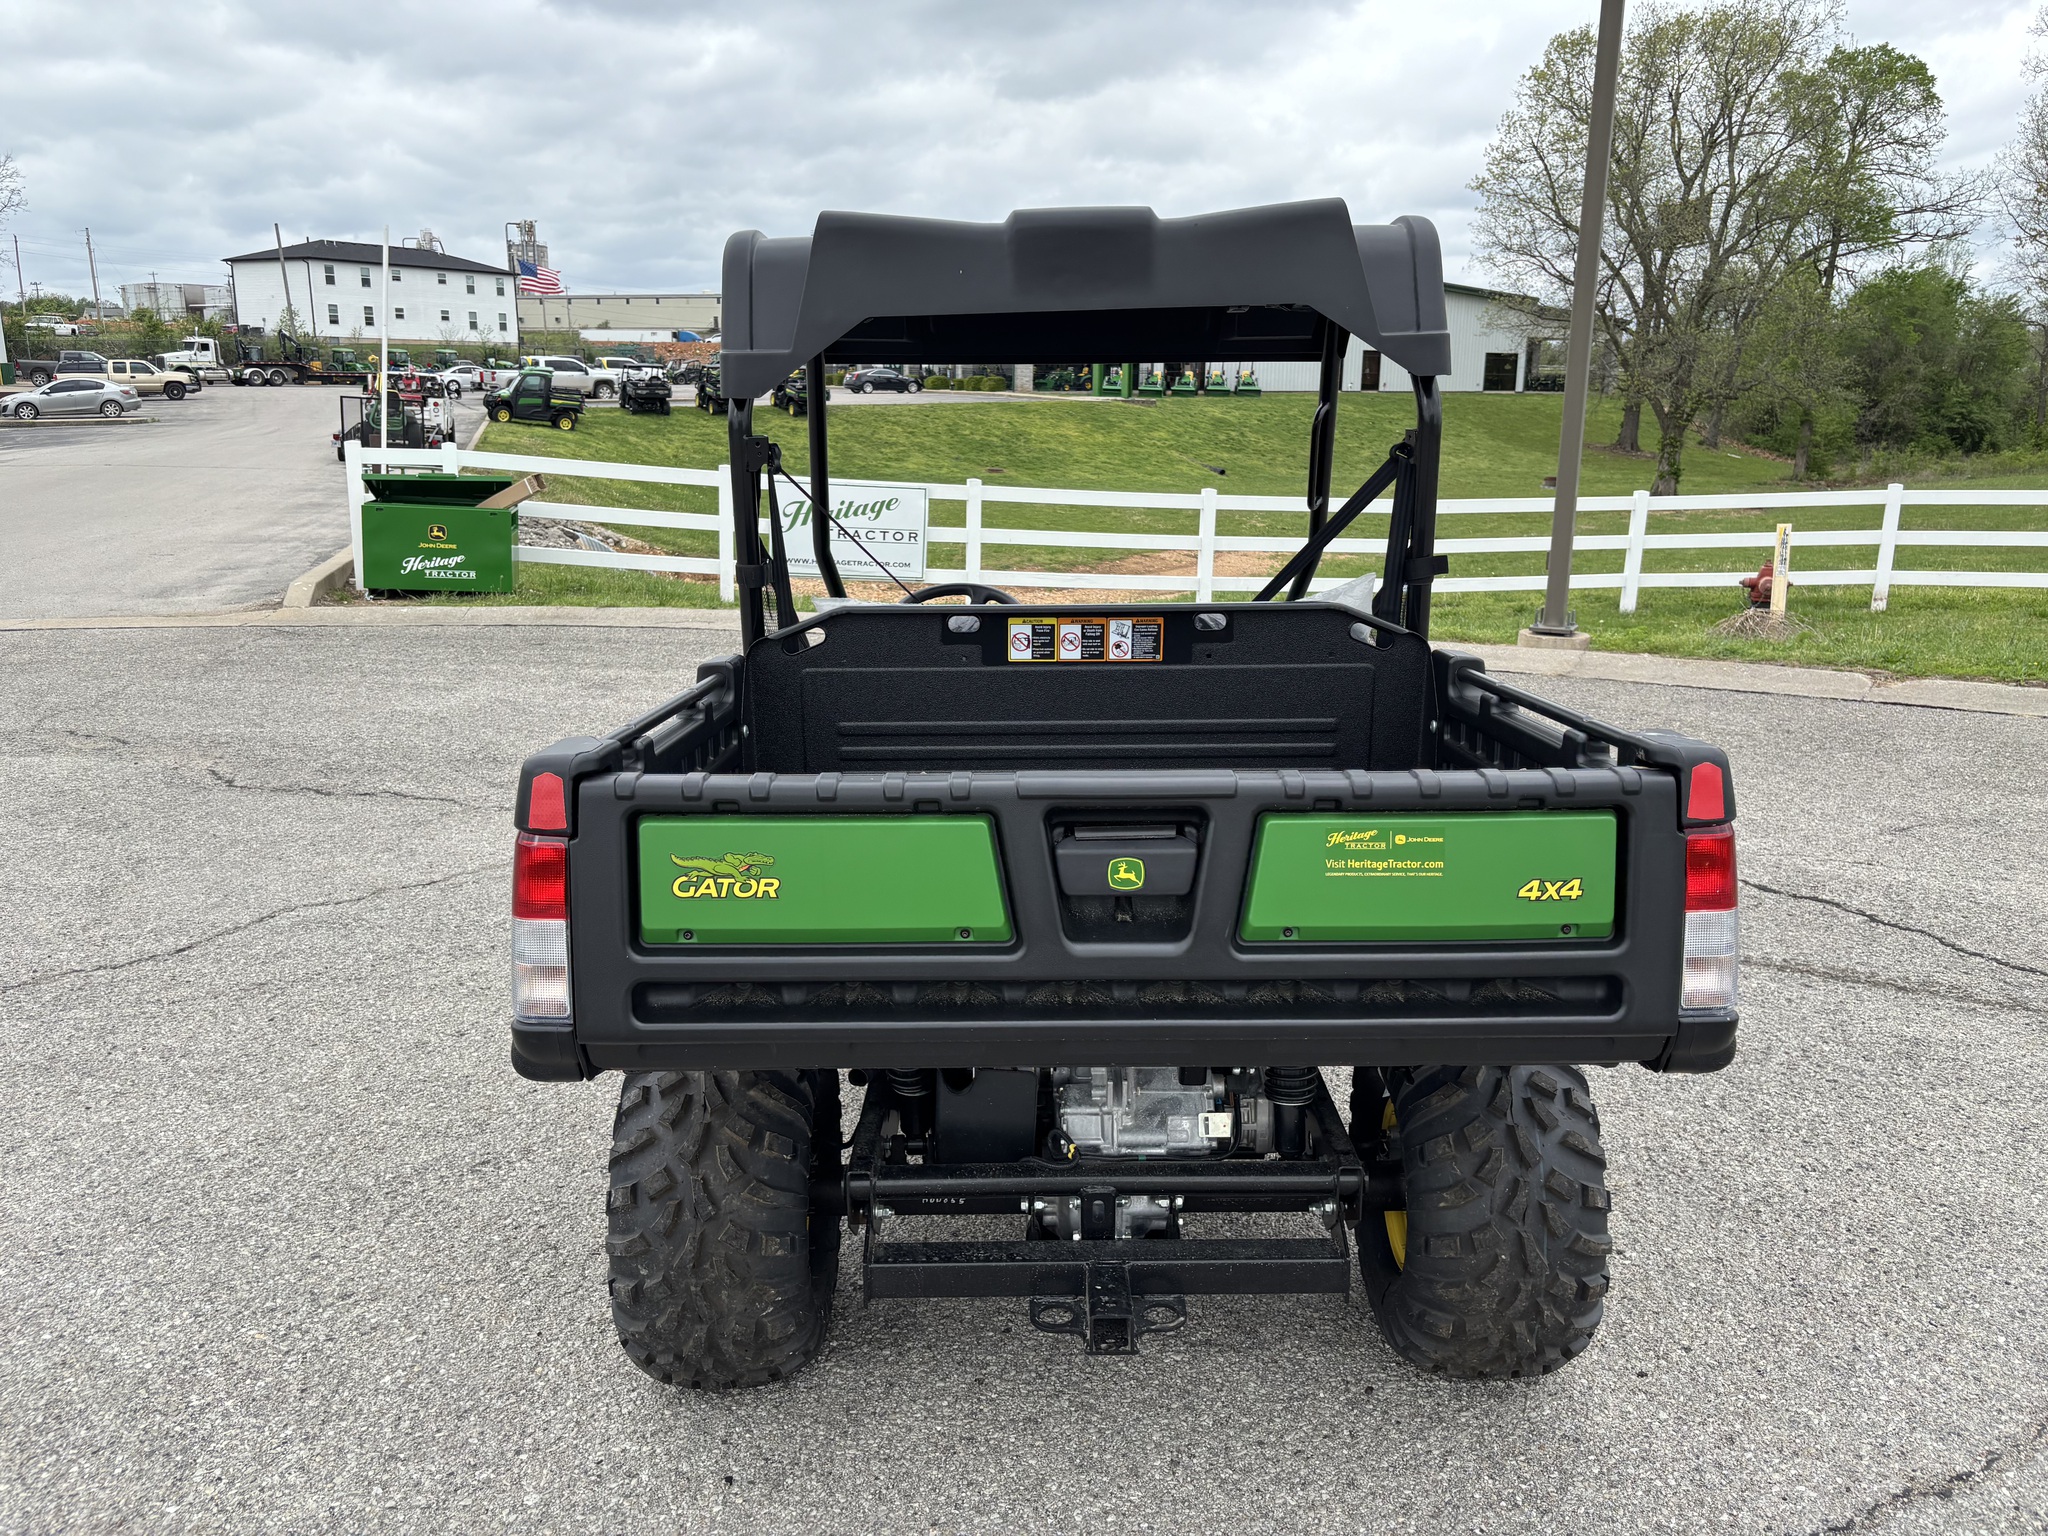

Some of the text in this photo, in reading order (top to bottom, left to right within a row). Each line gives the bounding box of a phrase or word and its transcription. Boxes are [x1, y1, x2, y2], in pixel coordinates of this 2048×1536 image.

[782, 497, 901, 533] Hitage
[829, 529, 918, 542] RACTOR
[400, 555, 466, 574] Heritage
[425, 571, 476, 579] TRACTOR
[1326, 829, 1378, 847] Heritage
[1325, 859, 1444, 871] Visit HeritageTractor.com
[671, 875, 781, 899] GATOR
[1517, 877, 1584, 901] 4x4
